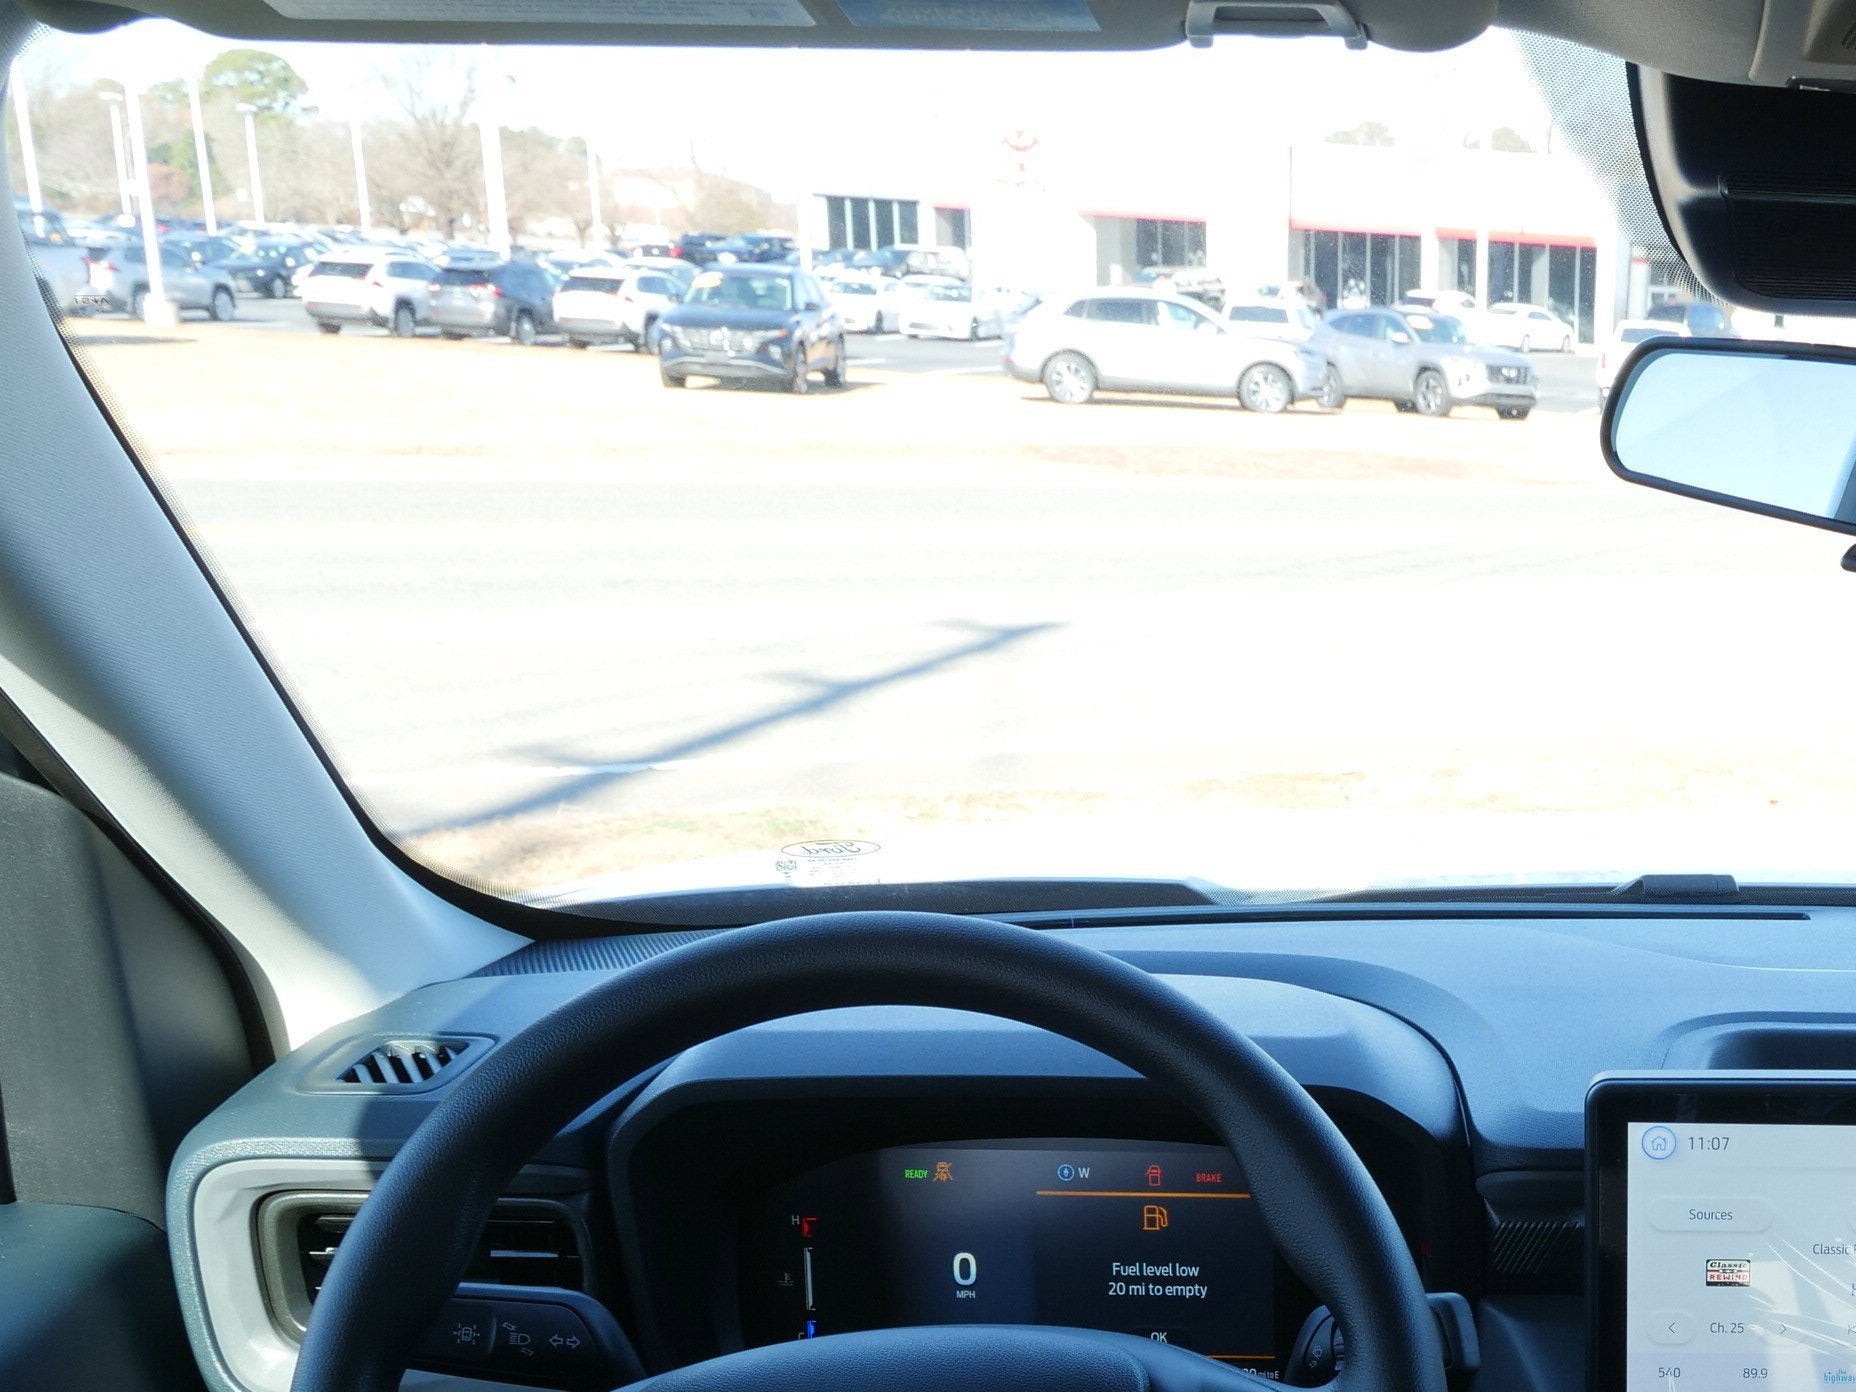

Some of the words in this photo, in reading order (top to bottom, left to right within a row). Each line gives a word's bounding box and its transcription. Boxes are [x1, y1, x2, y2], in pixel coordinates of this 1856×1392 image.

[1688, 1136, 1730, 1151] 11:07
[905, 1169, 928, 1180] READY
[1078, 1167, 1090, 1179] W
[1196, 1172, 1223, 1183] BRAKE
[791, 1215, 800, 1225] H
[1688, 1208, 1733, 1221] Sources
[1812, 1243, 1850, 1256] Classic
[953, 1252, 977, 1286] 0
[1112, 1262, 1140, 1276] Fuel
[1143, 1262, 1173, 1276] level
[1176, 1263, 1200, 1276] low
[956, 1290, 976, 1299] MPH
[1108, 1282, 1126, 1295] 20
[1129, 1282, 1145, 1295] mi
[1149, 1283, 1163, 1295] to
[1165, 1283, 1208, 1299] empty
[1709, 1322, 1725, 1334] Ch.
[1727, 1322, 1745, 1334] 25
[1150, 1332, 1168, 1343] OK
[1658, 1367, 1681, 1379] 540
[1742, 1368, 1768, 1379] 89.9
